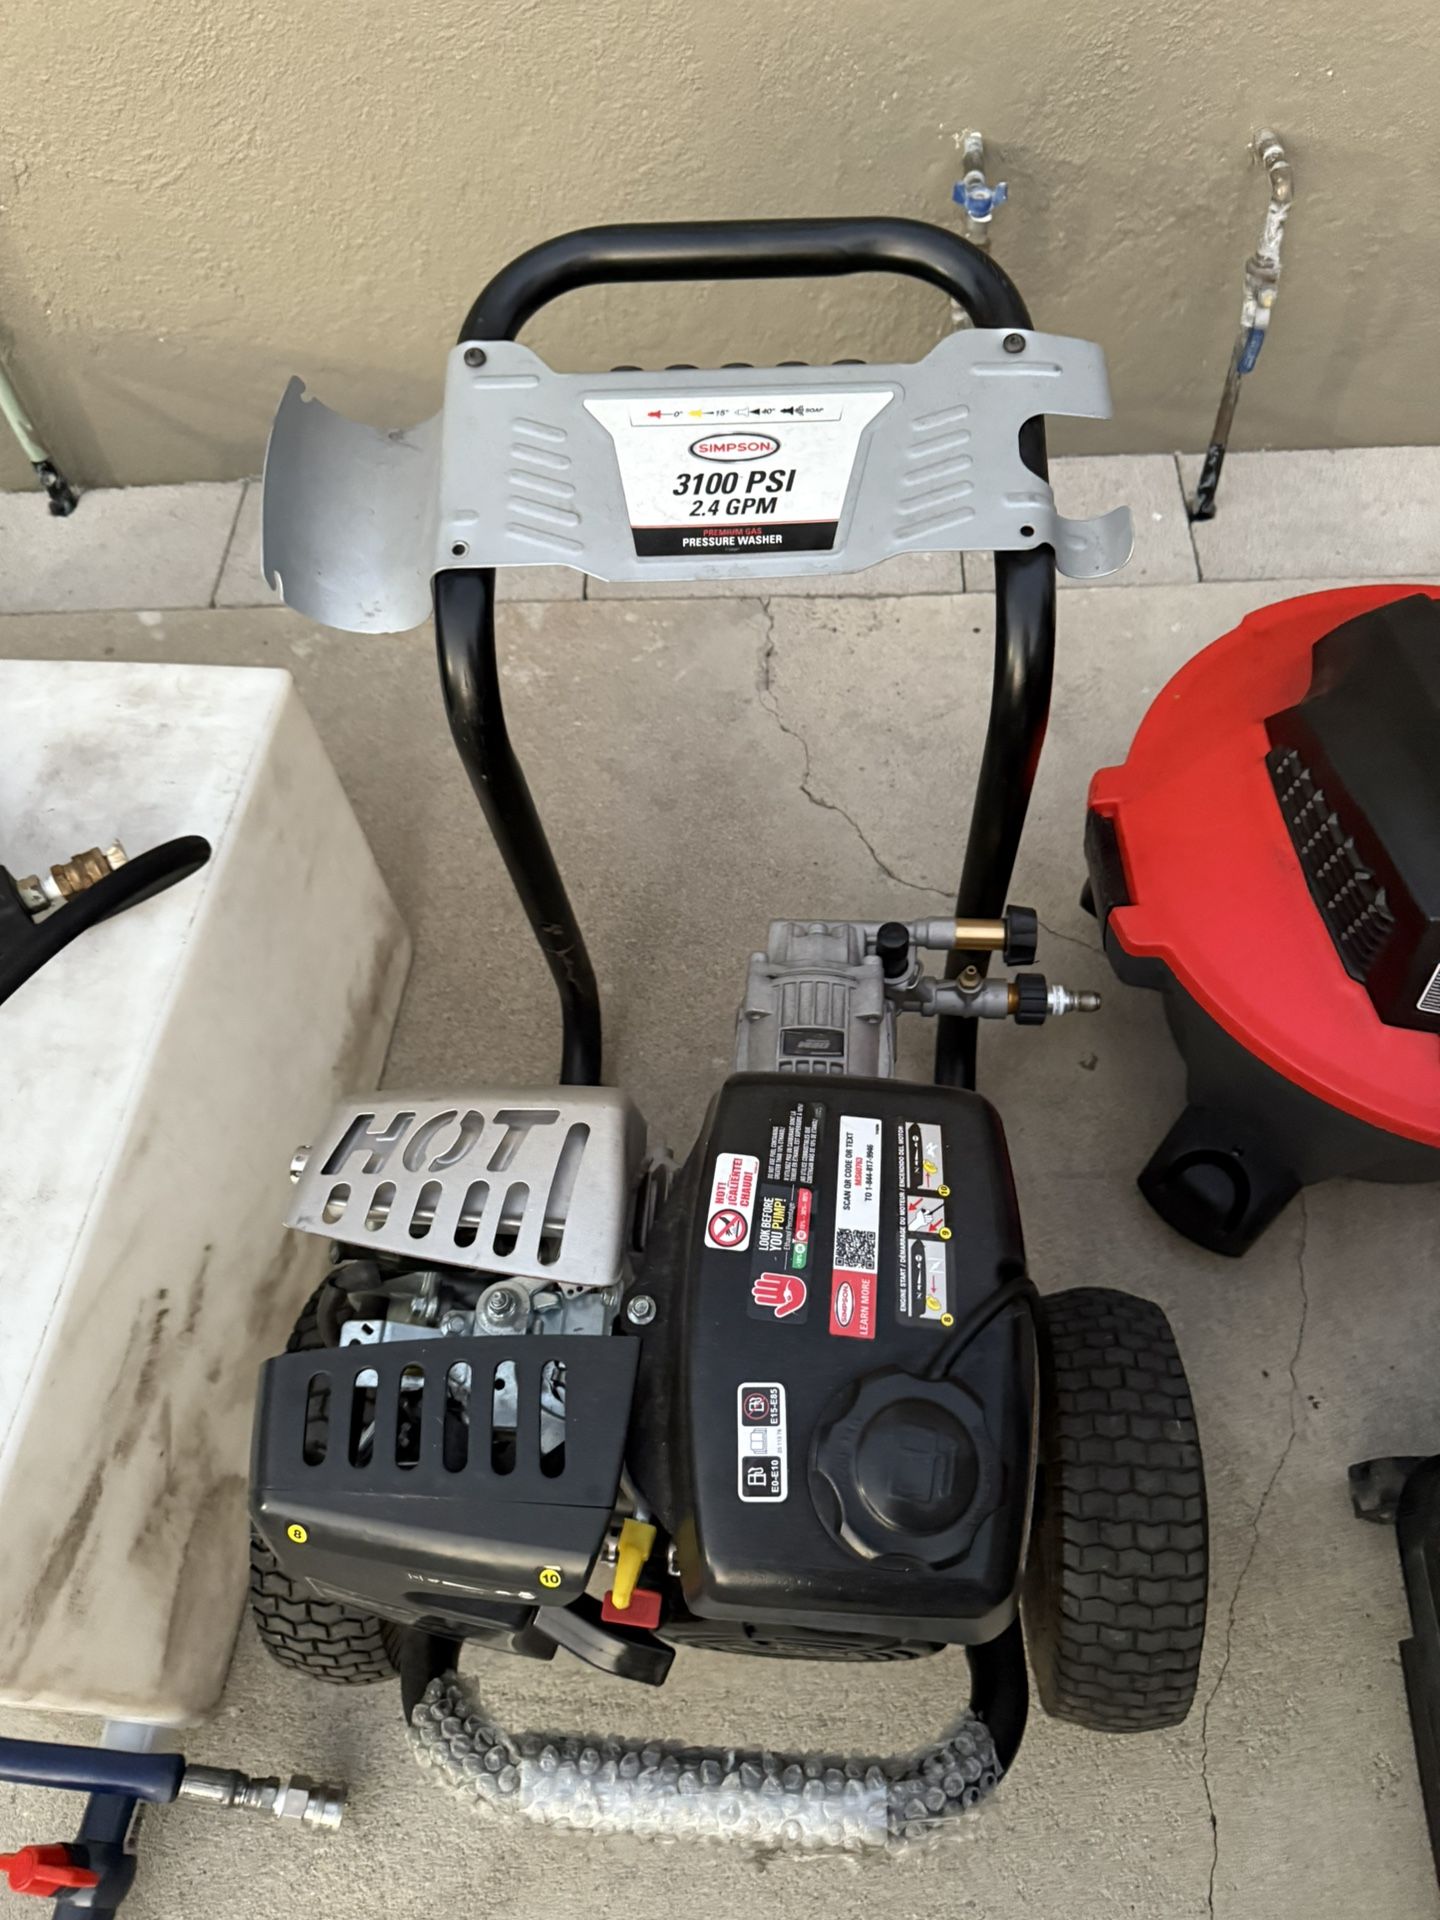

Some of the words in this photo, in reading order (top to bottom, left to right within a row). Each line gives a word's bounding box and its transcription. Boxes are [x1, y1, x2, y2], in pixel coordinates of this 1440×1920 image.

[699, 442, 771, 453] SIMPSON
[673, 472, 739, 496] 3100
[745, 469, 797, 493] PSI
[689, 500, 720, 516] 2.4
[726, 497, 778, 515] GPM
[683, 536, 735, 547] PRESSURE
[738, 535, 782, 545] WASHER
[321, 1109, 561, 1176] HOT
[846, 1149, 853, 1158] OR
[728, 1158, 742, 1205] ¡CALIENTE!
[740, 1172, 752, 1206] CHAUD!
[844, 1179, 851, 1189] QR
[715, 1182, 726, 1204] HOT!
[843, 1191, 851, 1210] SCAN
[865, 1192, 872, 1201] TO
[761, 1197, 773, 1228] BEFORE
[772, 1198, 786, 1229] PUMP!
[786, 1202, 795, 1229] Percentage
[900, 1217, 905, 1225] DU
[758, 1230, 770, 1251] LOOK
[770, 1232, 782, 1251] YOU
[784, 1231, 792, 1250] Ethanol
[898, 1227, 906, 1263] DÉMARRAGE
[861, 1279, 870, 1304] MORE
[859, 1306, 869, 1335] LEARN
[770, 1389, 778, 1424] E15-E85
[771, 1460, 779, 1493] E0-E10
[294, 1530, 302, 1538] 8
[542, 1574, 559, 1583] 10
